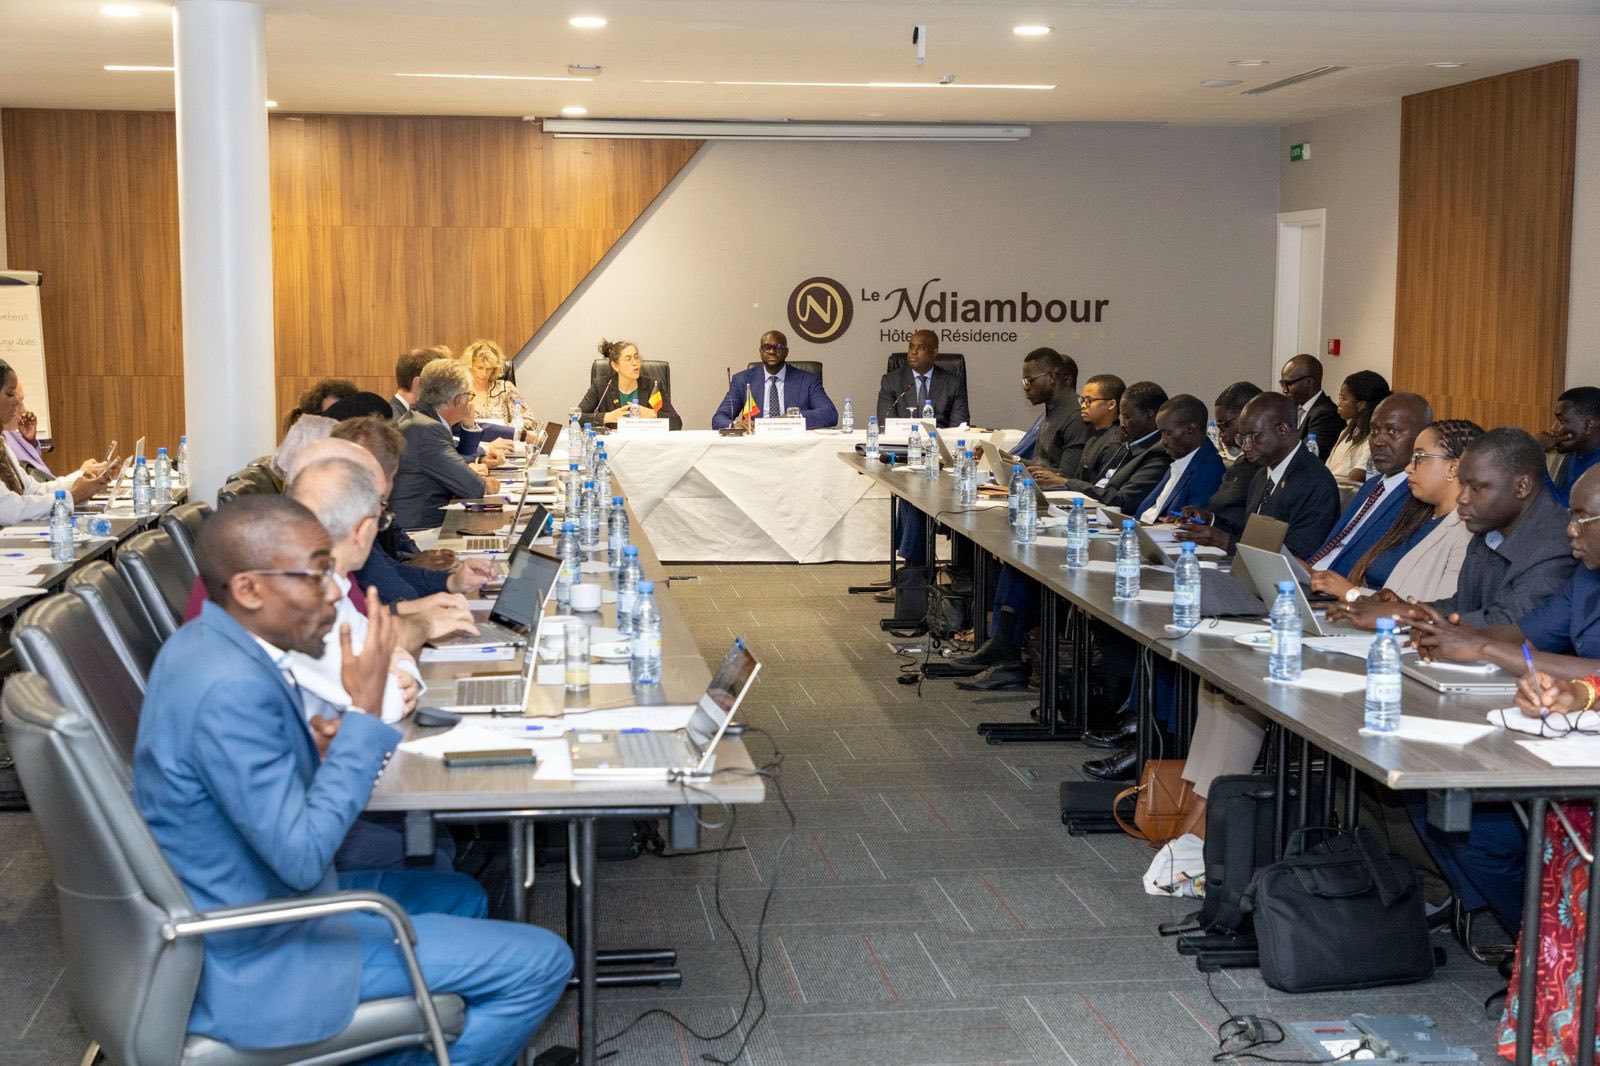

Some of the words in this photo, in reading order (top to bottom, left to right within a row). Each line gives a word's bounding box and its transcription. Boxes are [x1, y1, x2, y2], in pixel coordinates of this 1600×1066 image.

[861, 288, 880, 301] Le
[879, 278, 1110, 323] Ndiambour
[880, 328, 918, 342] Hôte
[941, 328, 1018, 342] Résidence
